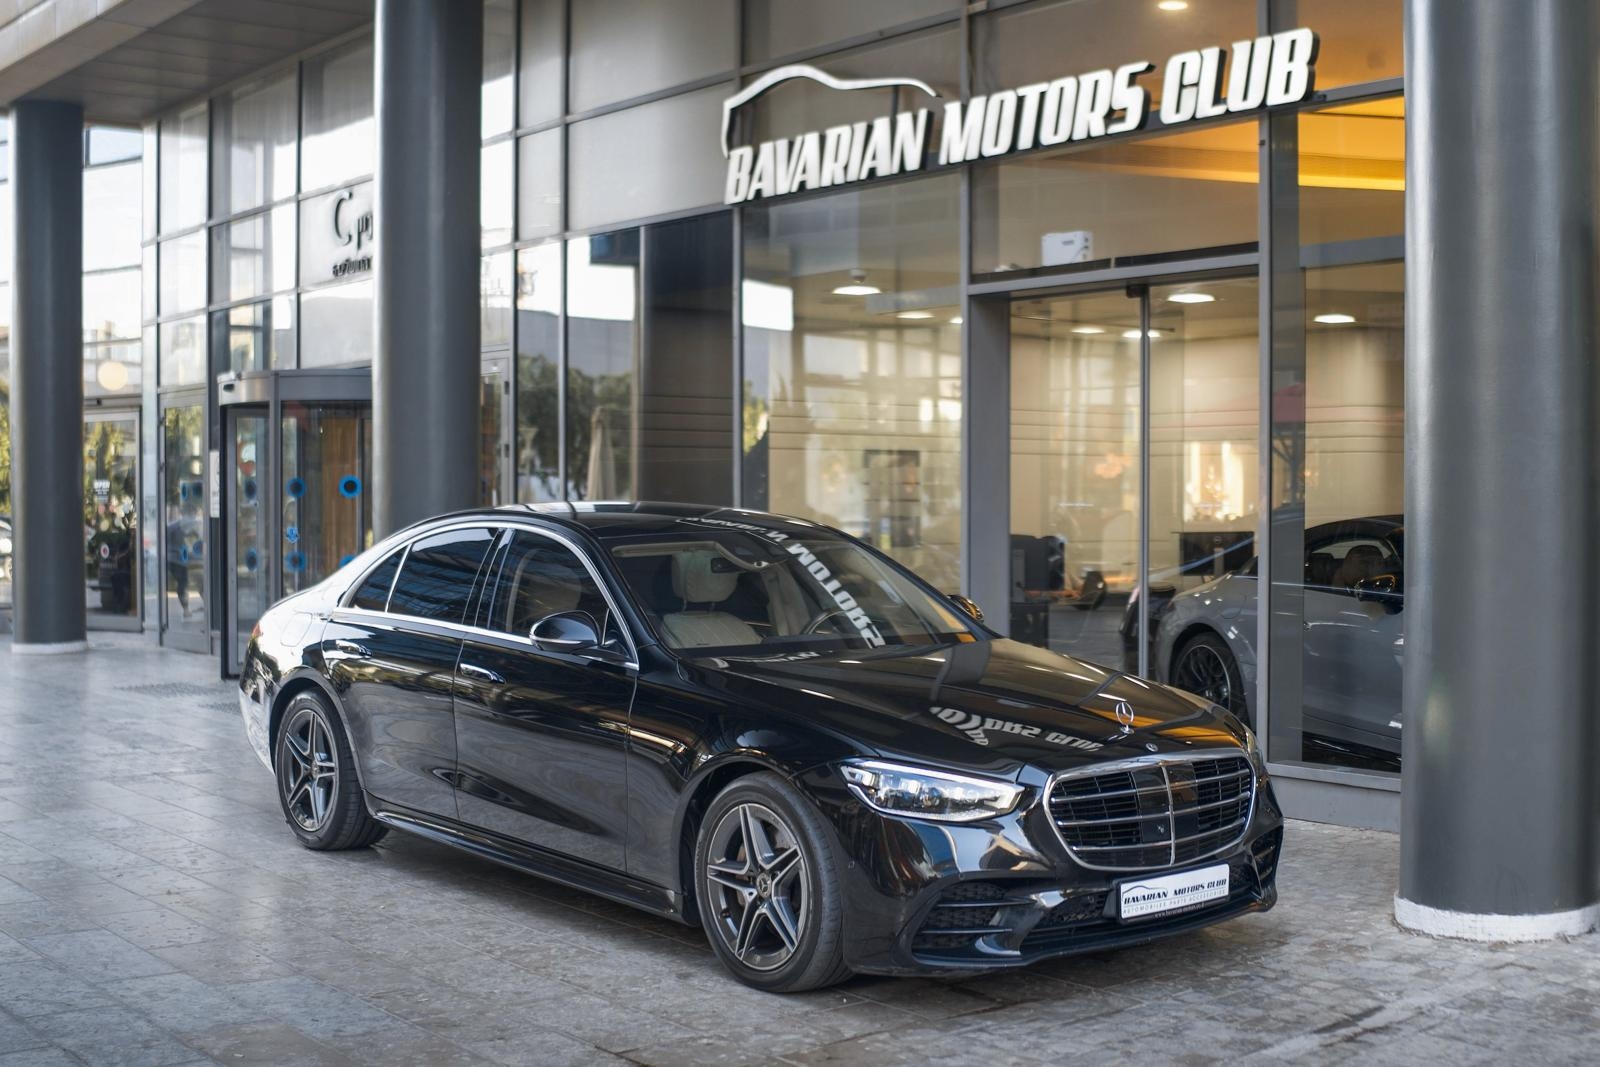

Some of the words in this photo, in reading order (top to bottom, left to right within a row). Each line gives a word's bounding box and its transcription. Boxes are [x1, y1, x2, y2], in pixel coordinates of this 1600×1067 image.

[724, 109, 931, 205] BAVARIAN
[938, 61, 1154, 165] MOTORS
[1159, 27, 1317, 124] CLUB
[1124, 891, 1168, 904] BAVARIAN
[1173, 884, 1205, 896] MOTORS
[1207, 878, 1227, 889] CLUB
